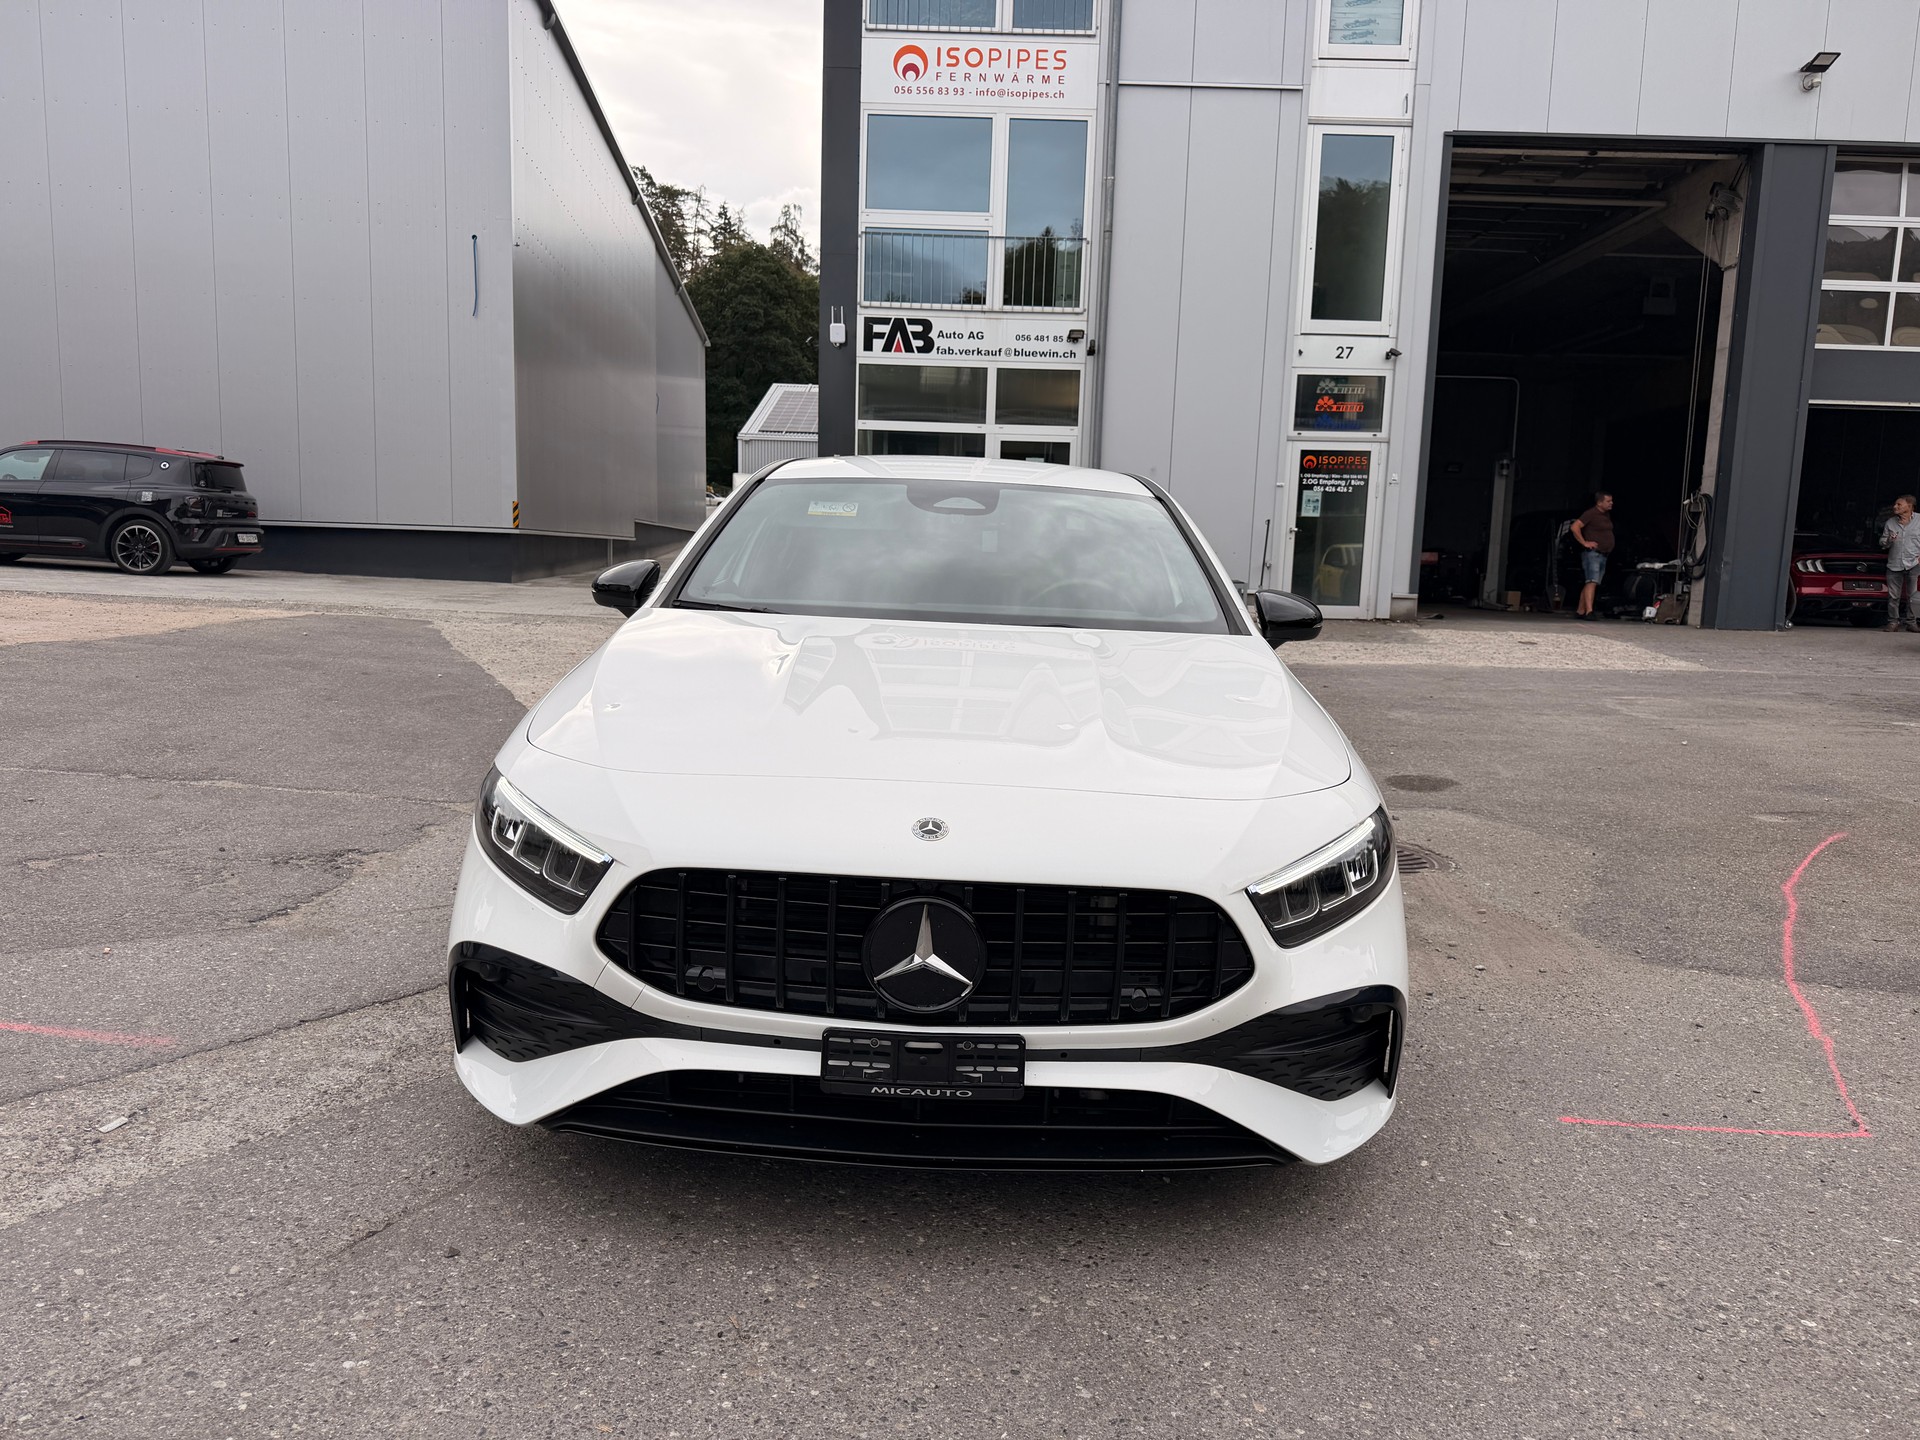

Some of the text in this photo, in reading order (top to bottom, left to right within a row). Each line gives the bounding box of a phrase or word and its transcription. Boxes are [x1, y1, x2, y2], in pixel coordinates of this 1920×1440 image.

[936, 46, 1067, 71] ISOPIPES
[935, 71, 1065, 85] FERNWÄRME
[894, 85, 913, 95] 056
[916, 86, 934, 96] 556
[937, 86, 949, 96] 83
[953, 87, 965, 96] 93
[975, 87, 1065, 99] info@isopipes.ch
[863, 316, 935, 354] FAB
[936, 329, 985, 341] Auto AG
[1015, 334, 1032, 342] 056
[1034, 334, 1050, 343] 481
[1052, 335, 1064, 343] 85
[1335, 346, 1354, 359] 27
[1318, 456, 1368, 464] ISOPIPES
[870, 1086, 973, 1098] MICAUTO
